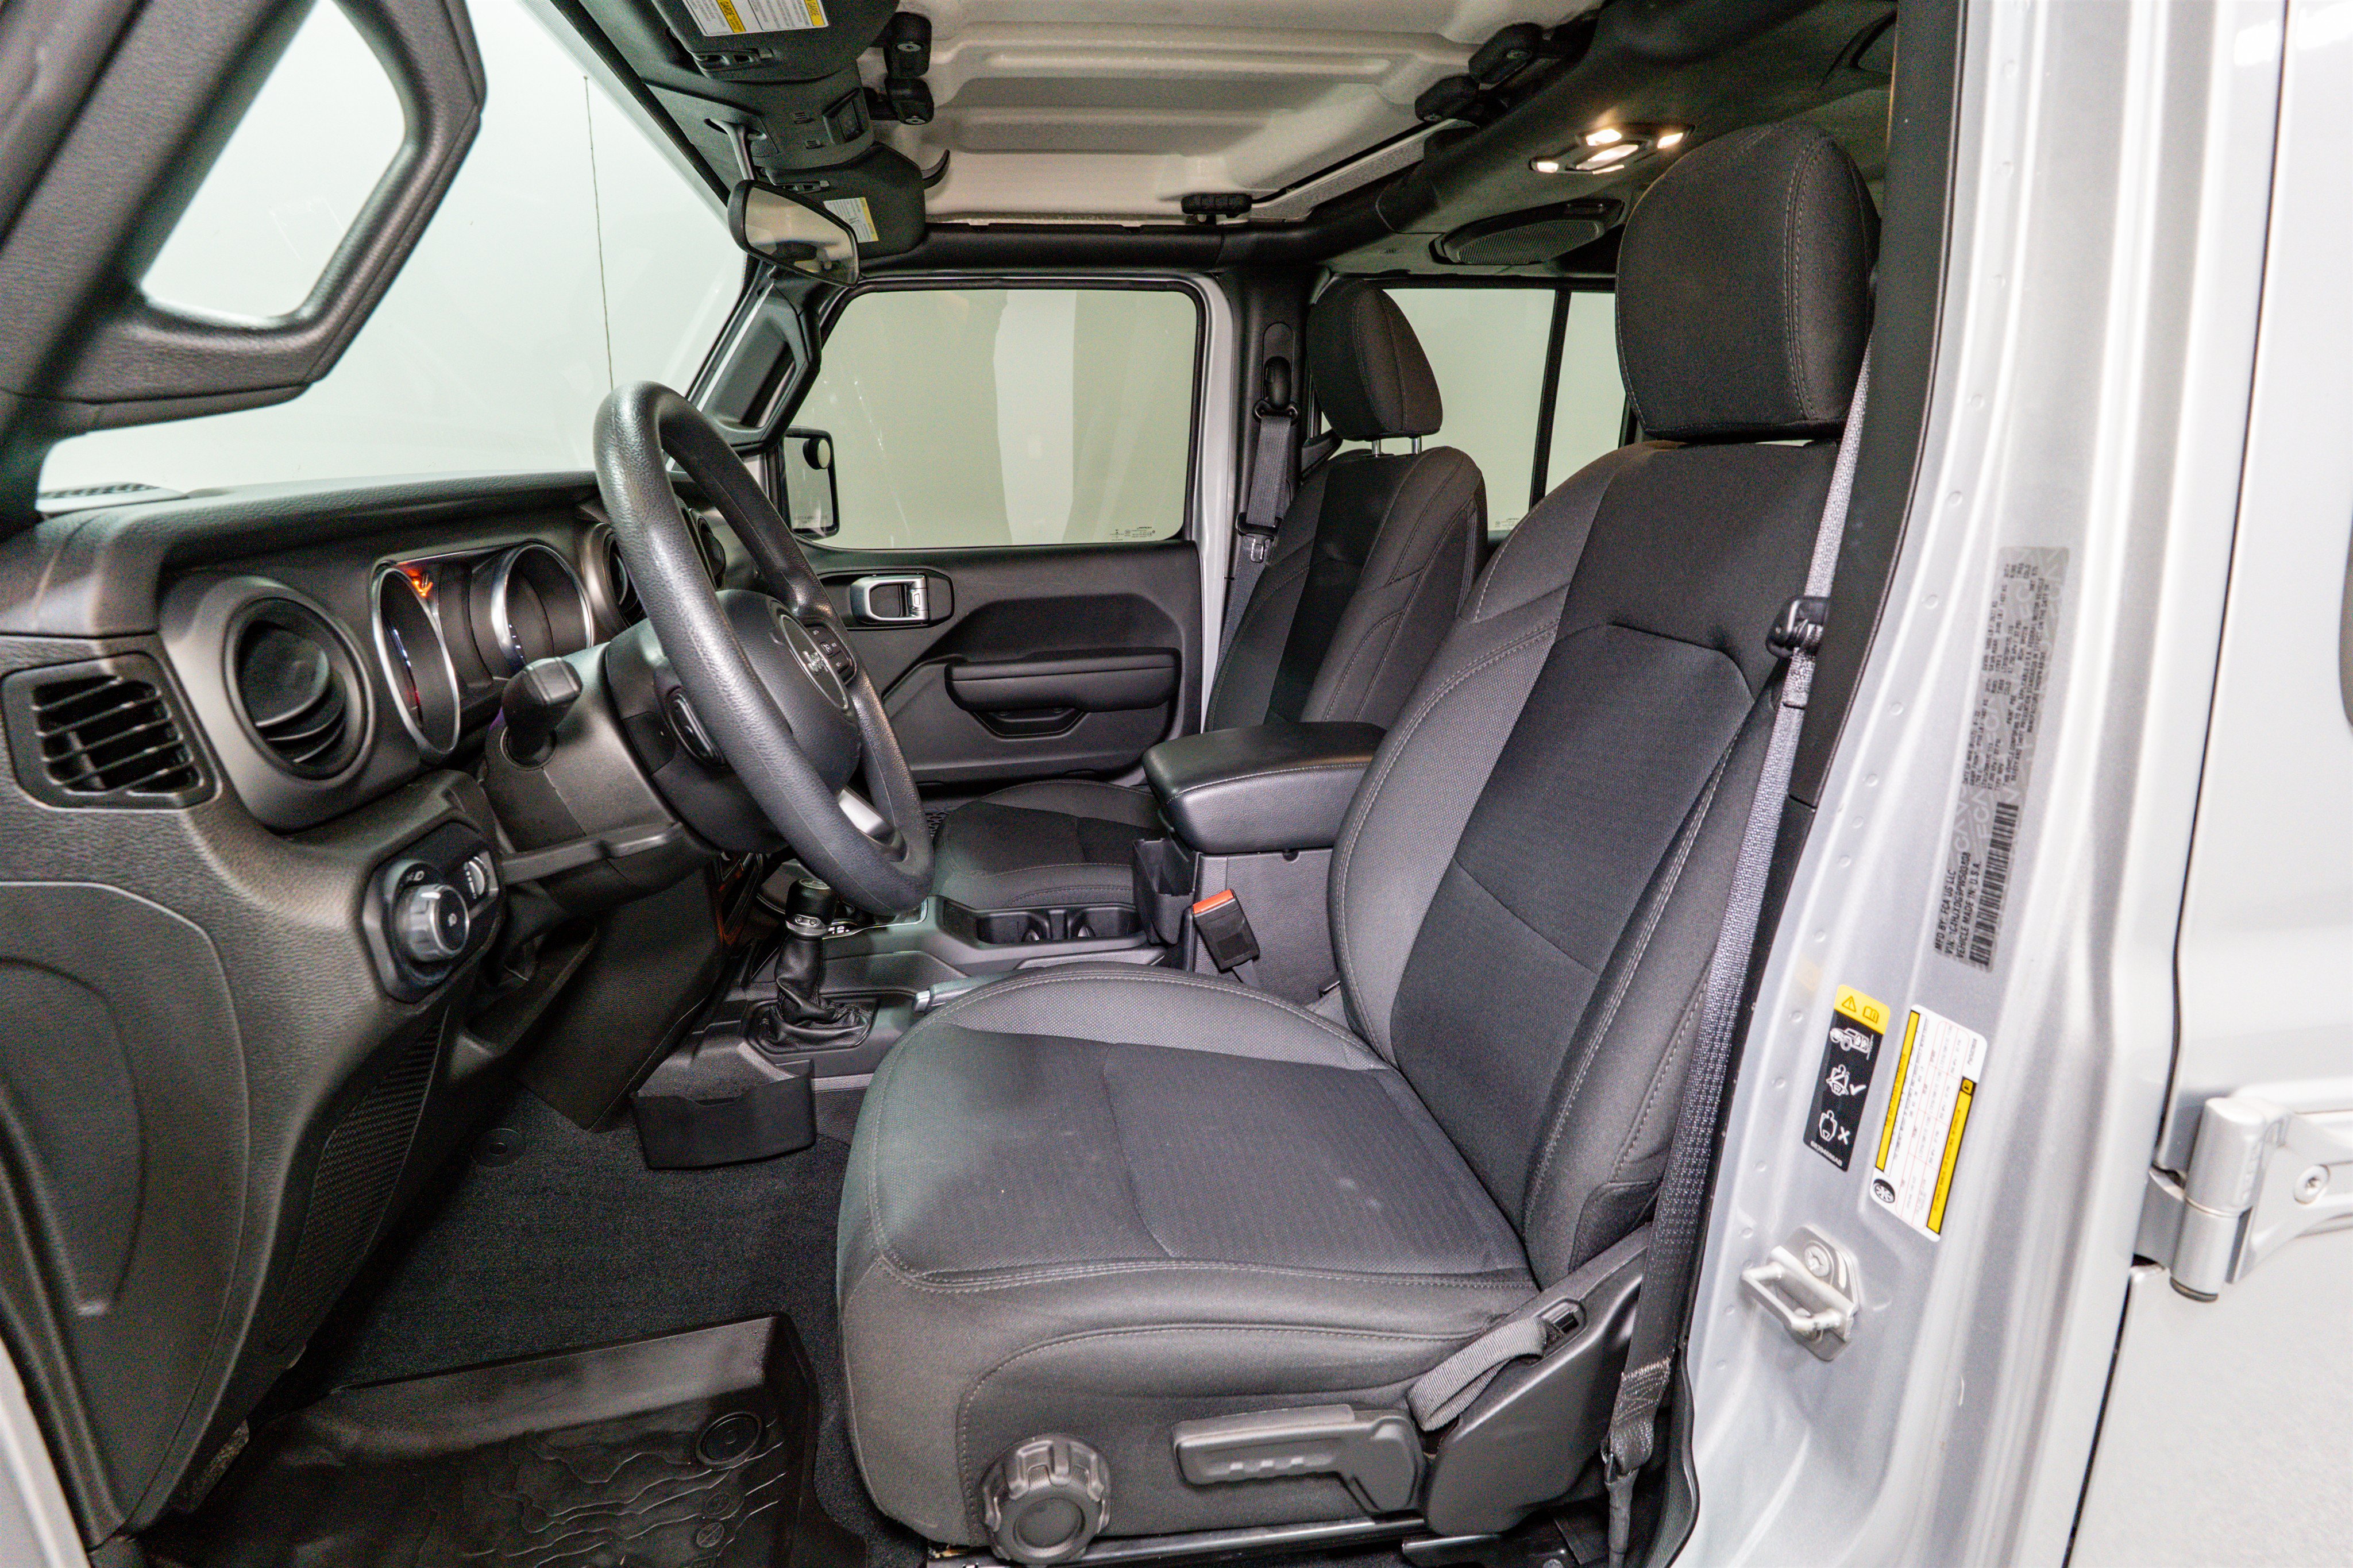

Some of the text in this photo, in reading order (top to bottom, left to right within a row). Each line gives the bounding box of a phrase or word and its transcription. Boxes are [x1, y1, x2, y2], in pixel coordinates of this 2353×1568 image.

[1935, 868, 1955, 951] MFD BY: FCA US LLC
[1962, 900, 1973, 924] MADE
[1945, 939, 1954, 955] VIN:
[1956, 926, 1969, 959] VEHICLE
